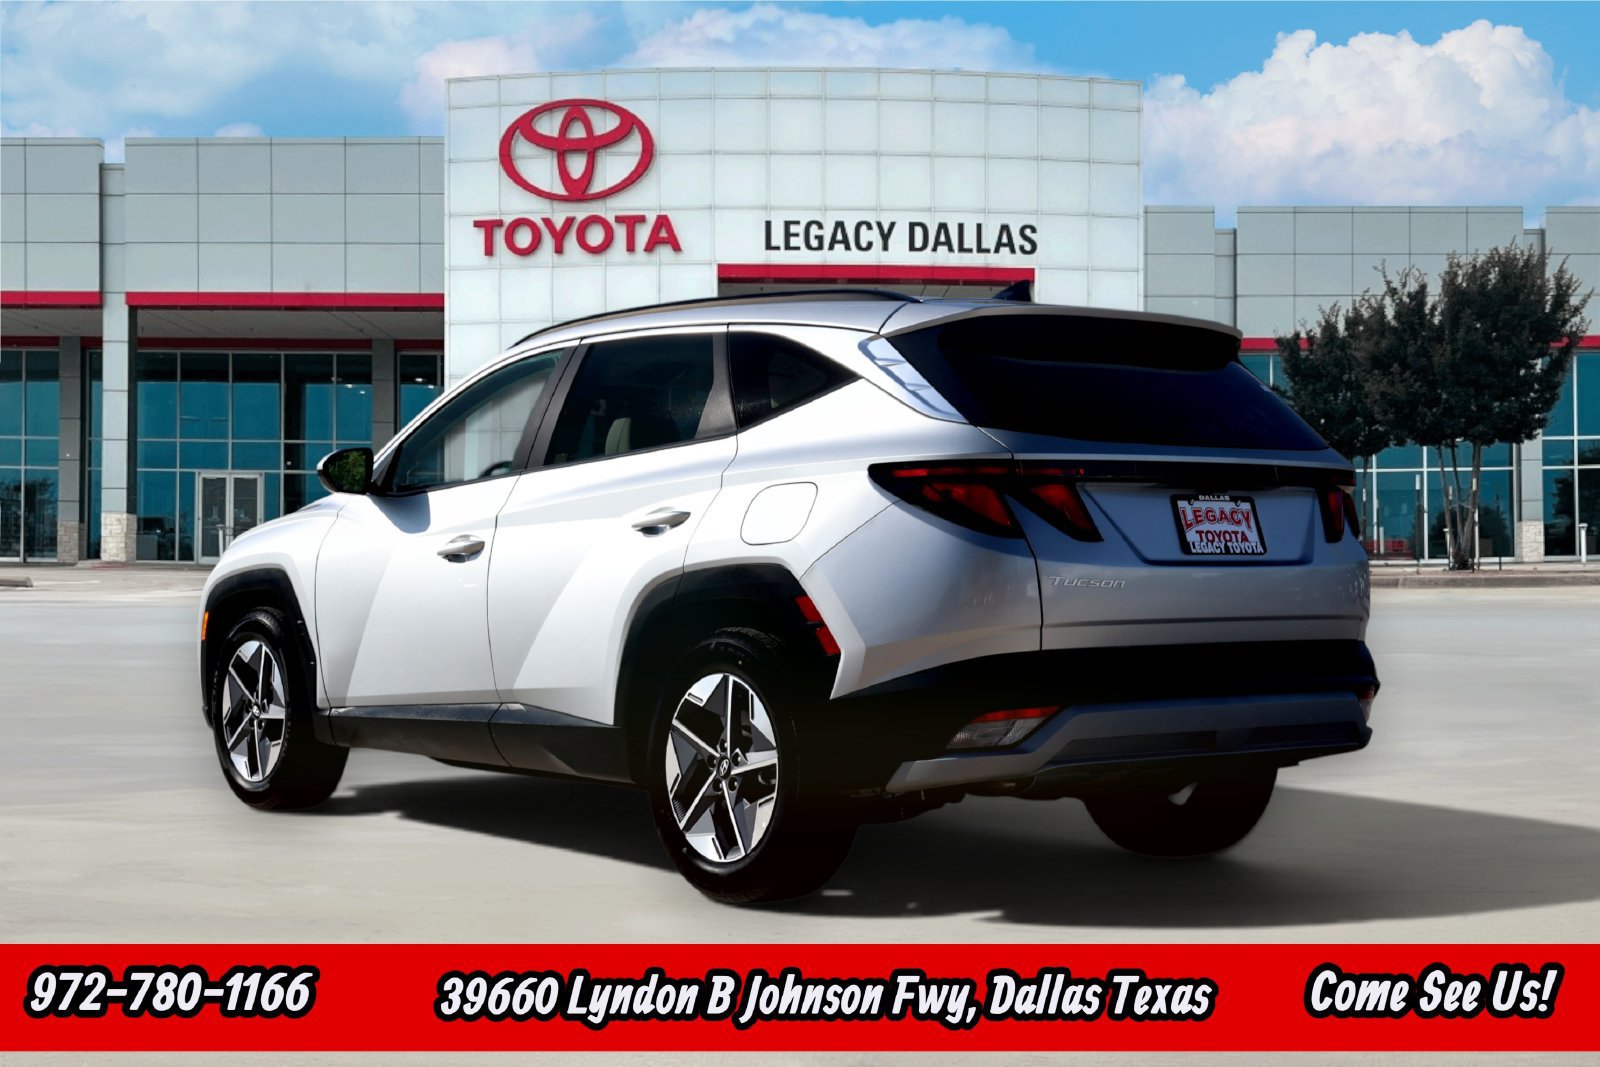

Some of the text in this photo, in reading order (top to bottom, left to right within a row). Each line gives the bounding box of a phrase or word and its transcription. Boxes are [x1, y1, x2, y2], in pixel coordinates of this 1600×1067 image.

[473, 214, 682, 257] TOYOTA
[765, 220, 1038, 255] LEGACY DALLAS
[1180, 506, 1252, 532] LEGACY
[1189, 541, 1264, 554] LEGACY TOYOTA
[1196, 530, 1249, 543] TOYOTA
